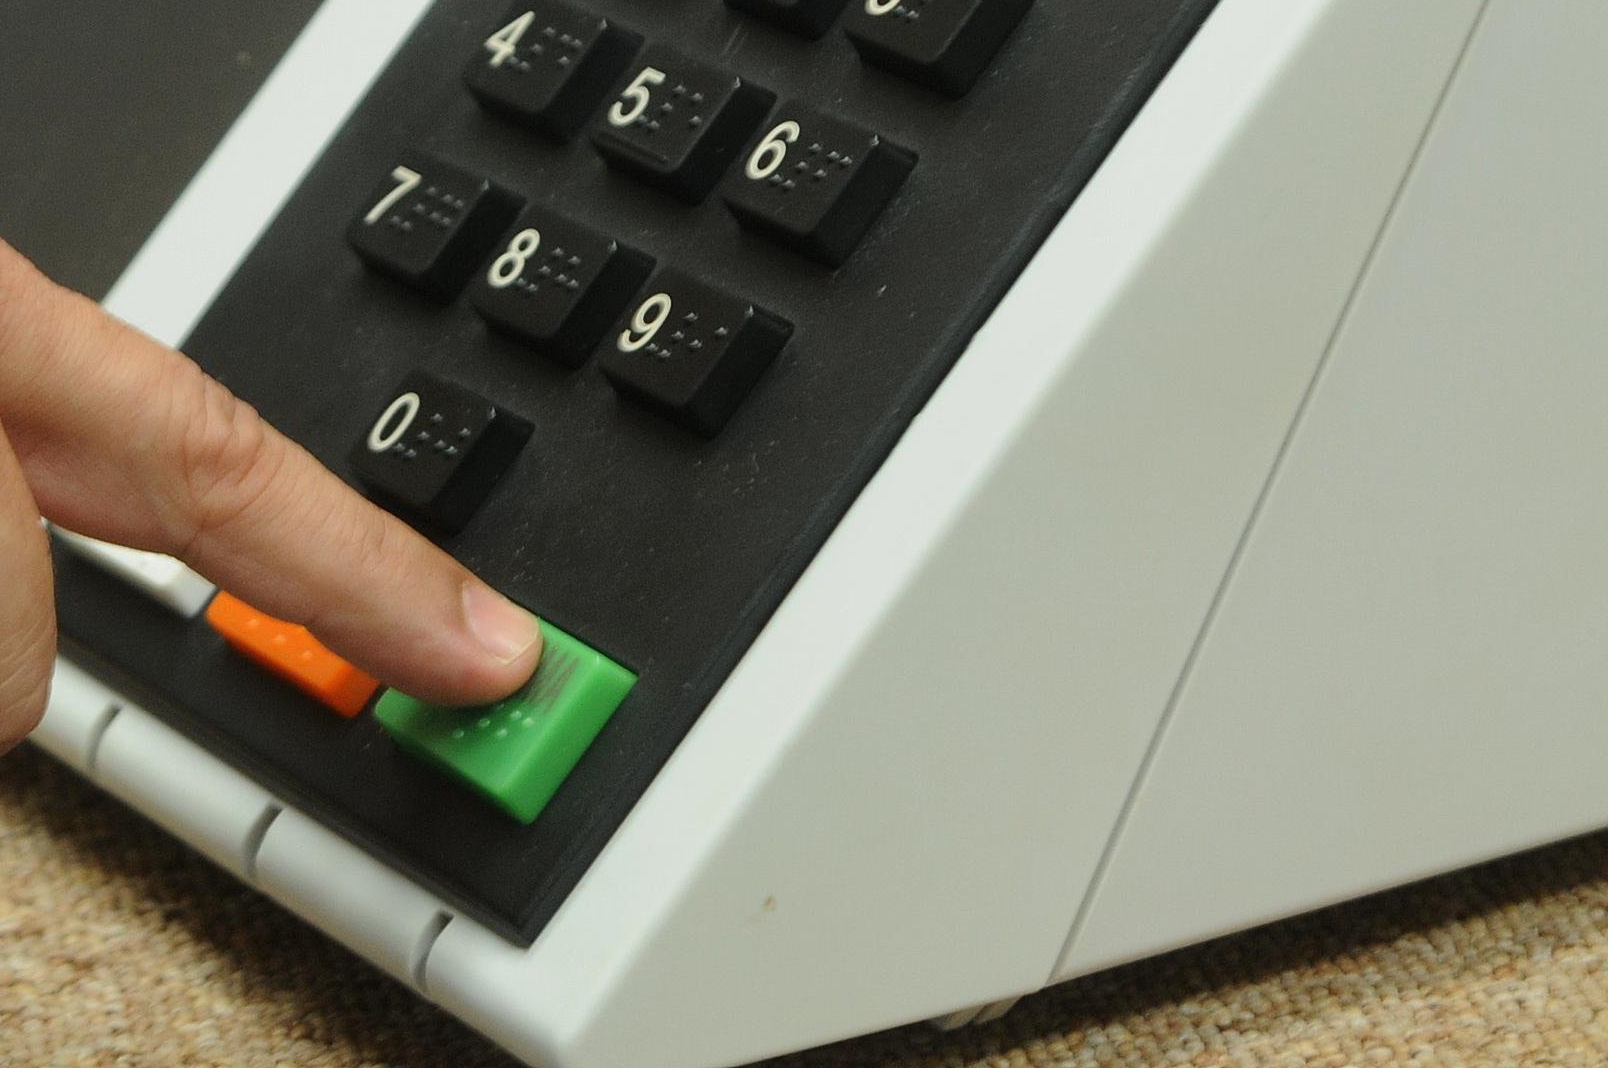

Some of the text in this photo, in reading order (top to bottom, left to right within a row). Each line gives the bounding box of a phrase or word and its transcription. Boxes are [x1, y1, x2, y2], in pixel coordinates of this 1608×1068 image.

[483, 10, 800, 180] 4 5 6
[364, 165, 672, 352] 7 8 9
[368, 392, 420, 451] 0
